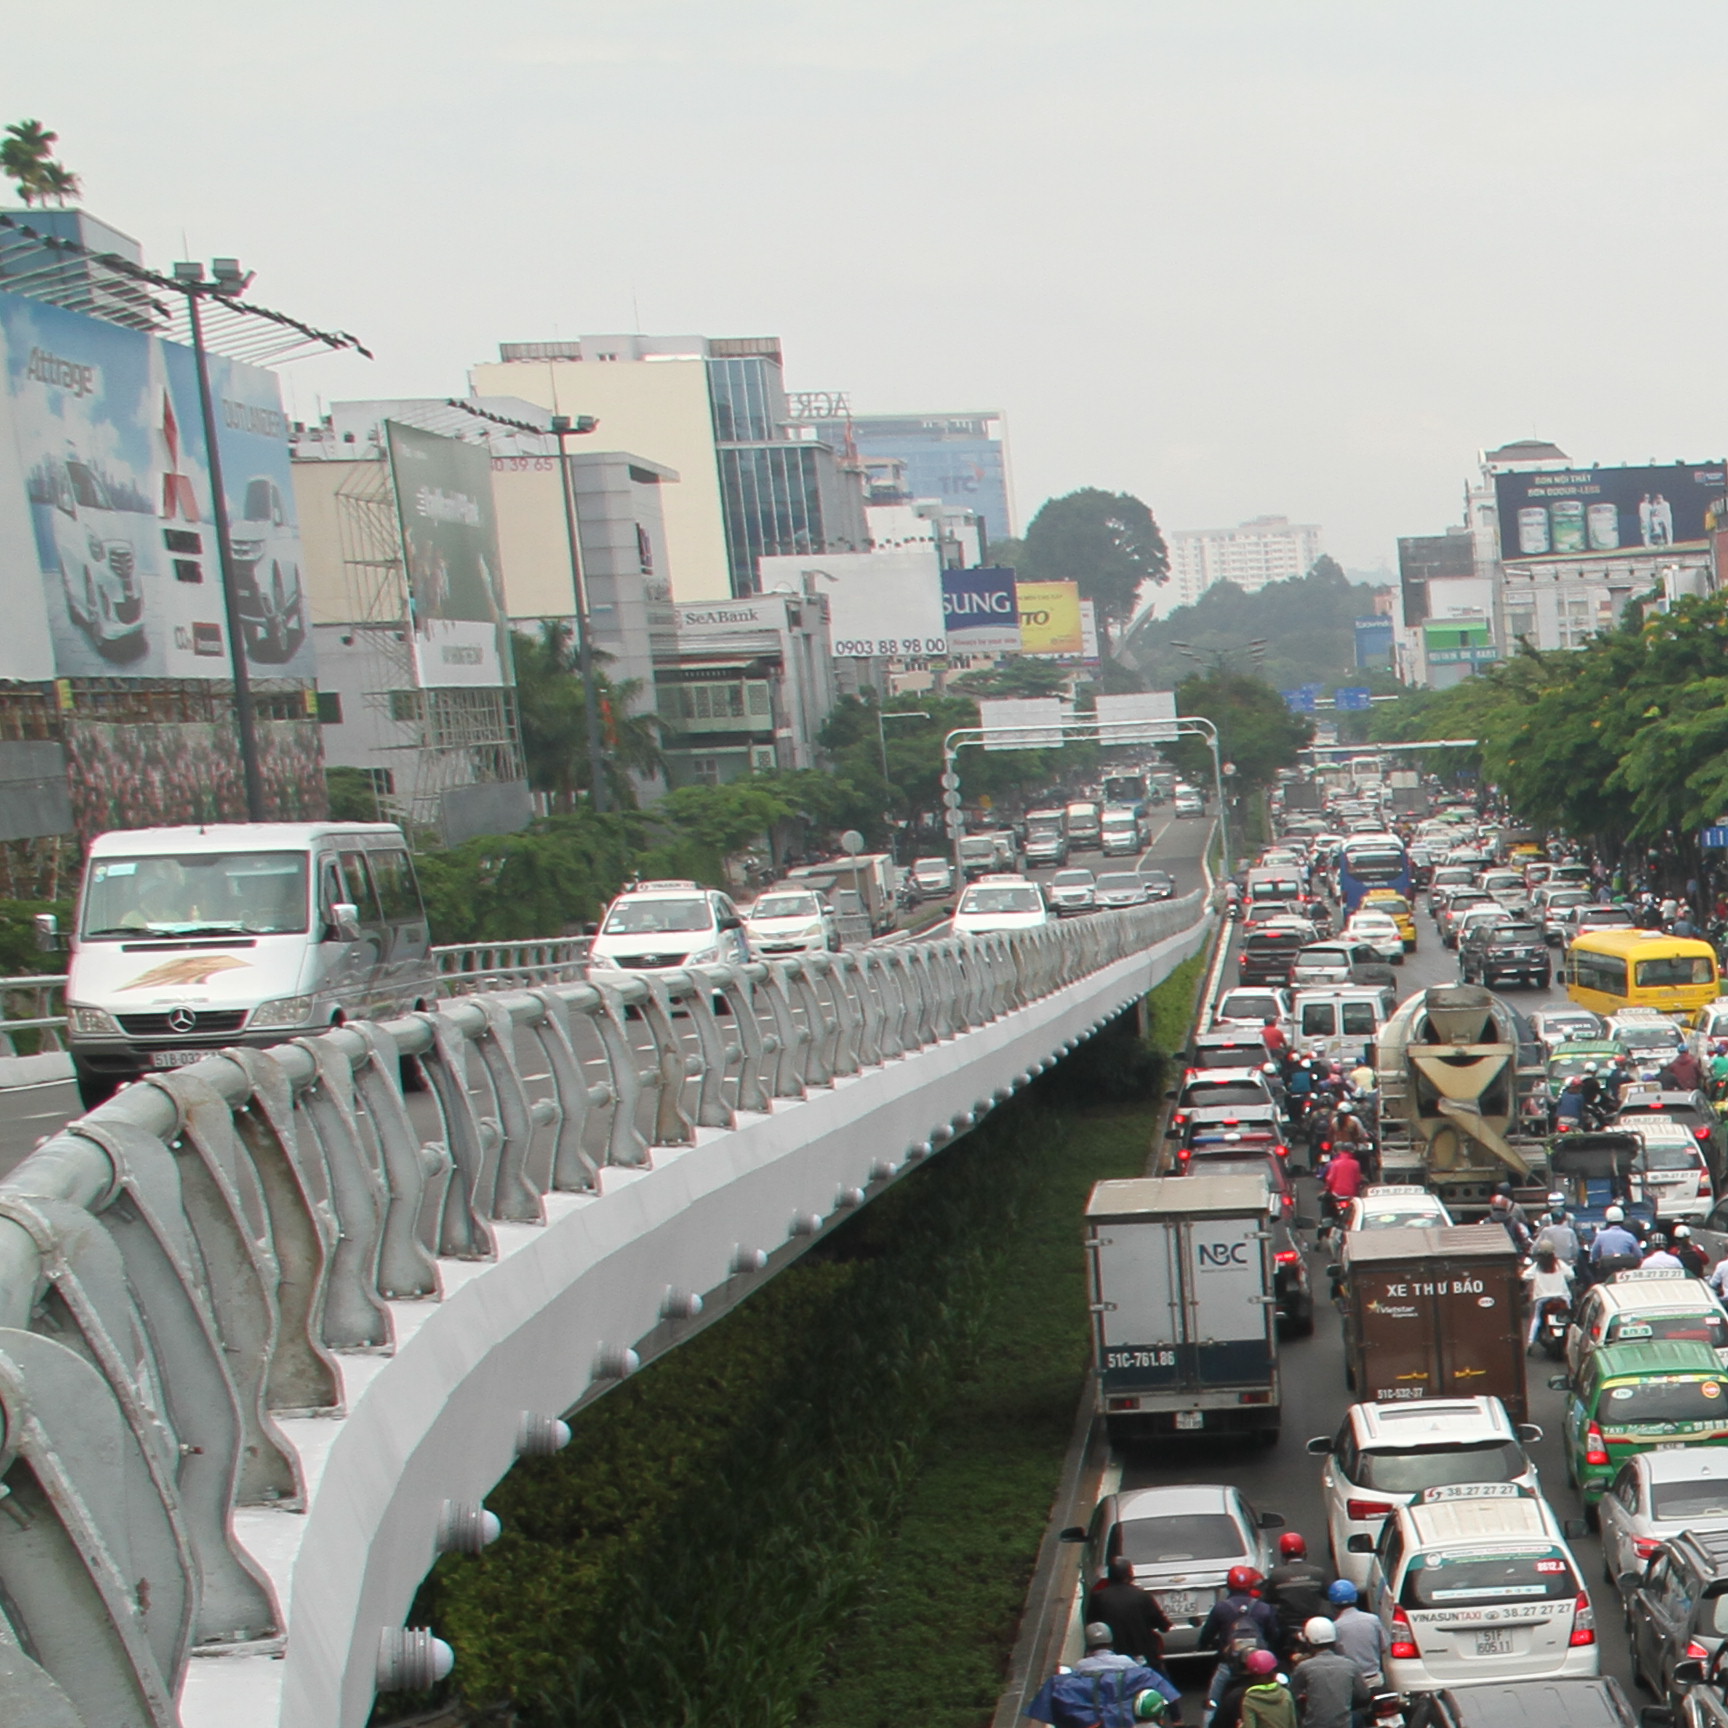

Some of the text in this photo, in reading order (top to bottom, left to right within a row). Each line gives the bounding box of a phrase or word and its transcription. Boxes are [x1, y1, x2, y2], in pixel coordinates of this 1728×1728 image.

[27, 345, 95, 399] Attrage
[685, 608, 760, 626] SeABank
[835, 638, 945, 656] 0903 88 98 00
[1197, 1242, 1247, 1266] NBC
[1387, 1284, 1407, 1298] XE
[1453, 1278, 1484, 1294] BÁO
[1108, 1350, 1176, 1368] 51C-761.86
